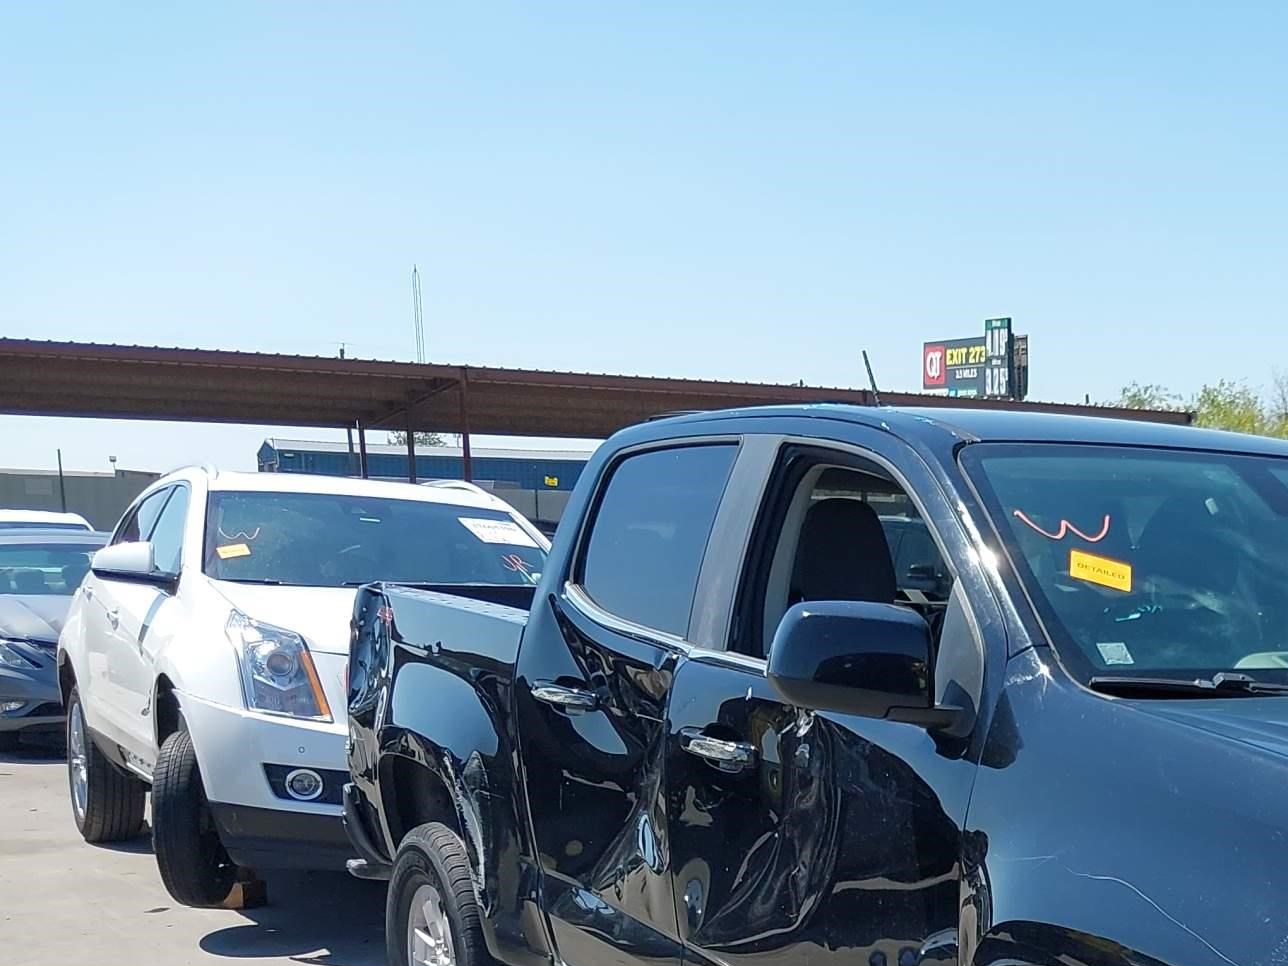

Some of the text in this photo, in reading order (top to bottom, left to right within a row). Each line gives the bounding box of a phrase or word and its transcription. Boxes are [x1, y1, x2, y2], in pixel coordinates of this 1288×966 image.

[926, 351, 942, 380] QT
[946, 347, 968, 366] EXIT
[968, 345, 986, 364] 273
[1076, 561, 1126, 581] DETAILED
